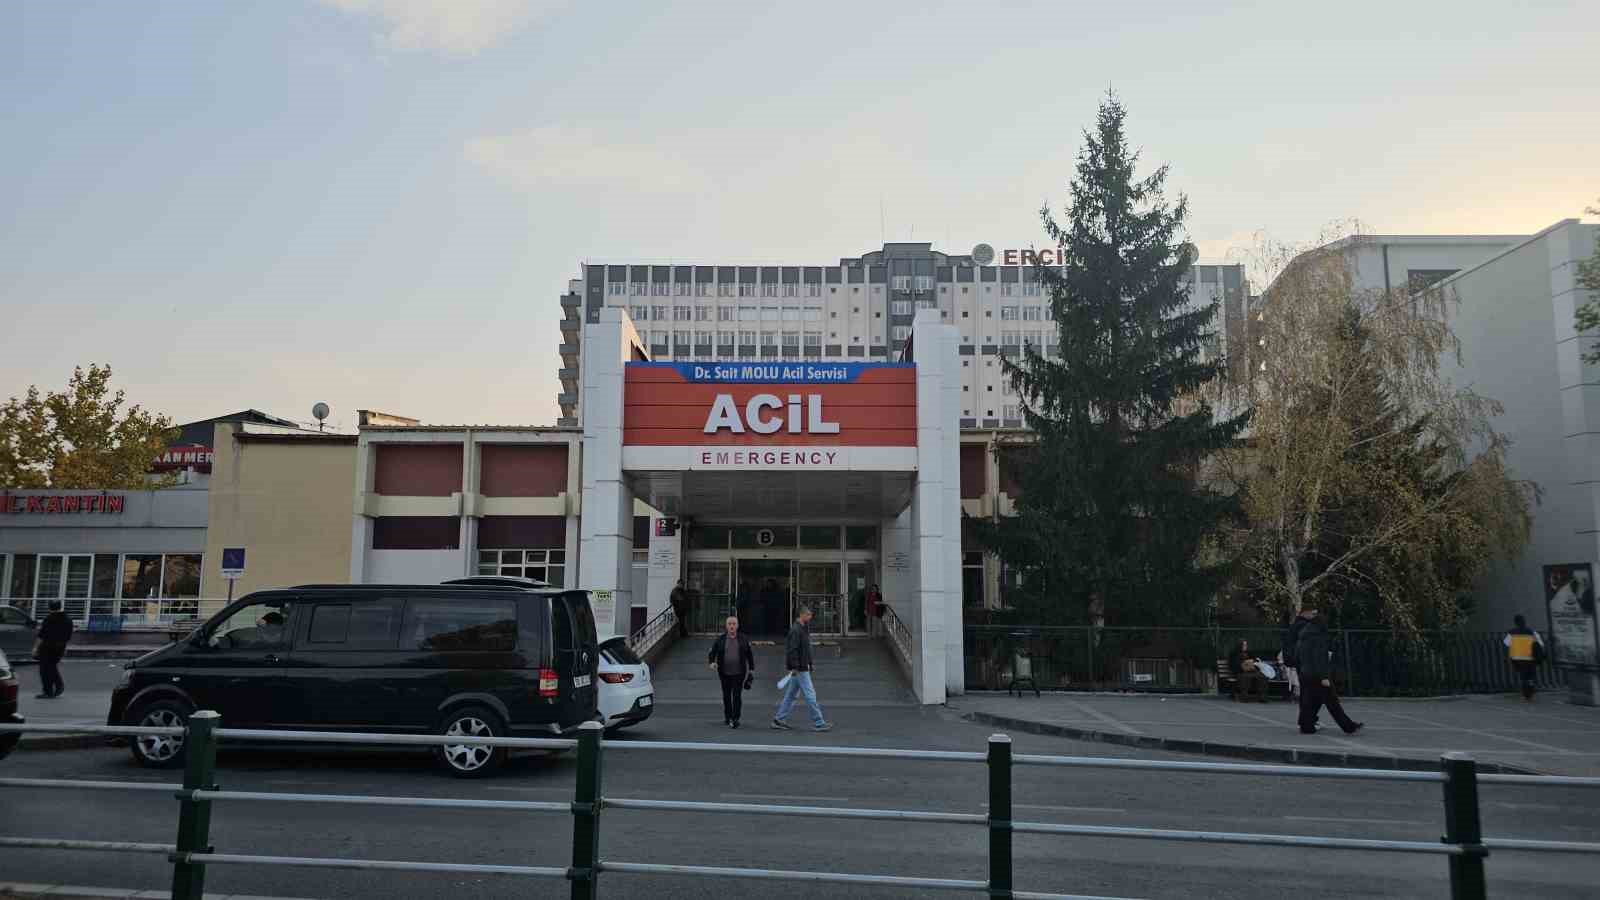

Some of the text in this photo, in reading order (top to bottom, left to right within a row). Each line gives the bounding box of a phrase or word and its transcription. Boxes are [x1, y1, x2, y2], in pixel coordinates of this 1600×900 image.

[695, 366, 847, 379] Dr. Sait MOLU Acil Servisi
[702, 452, 836, 465] EMERGENCY
